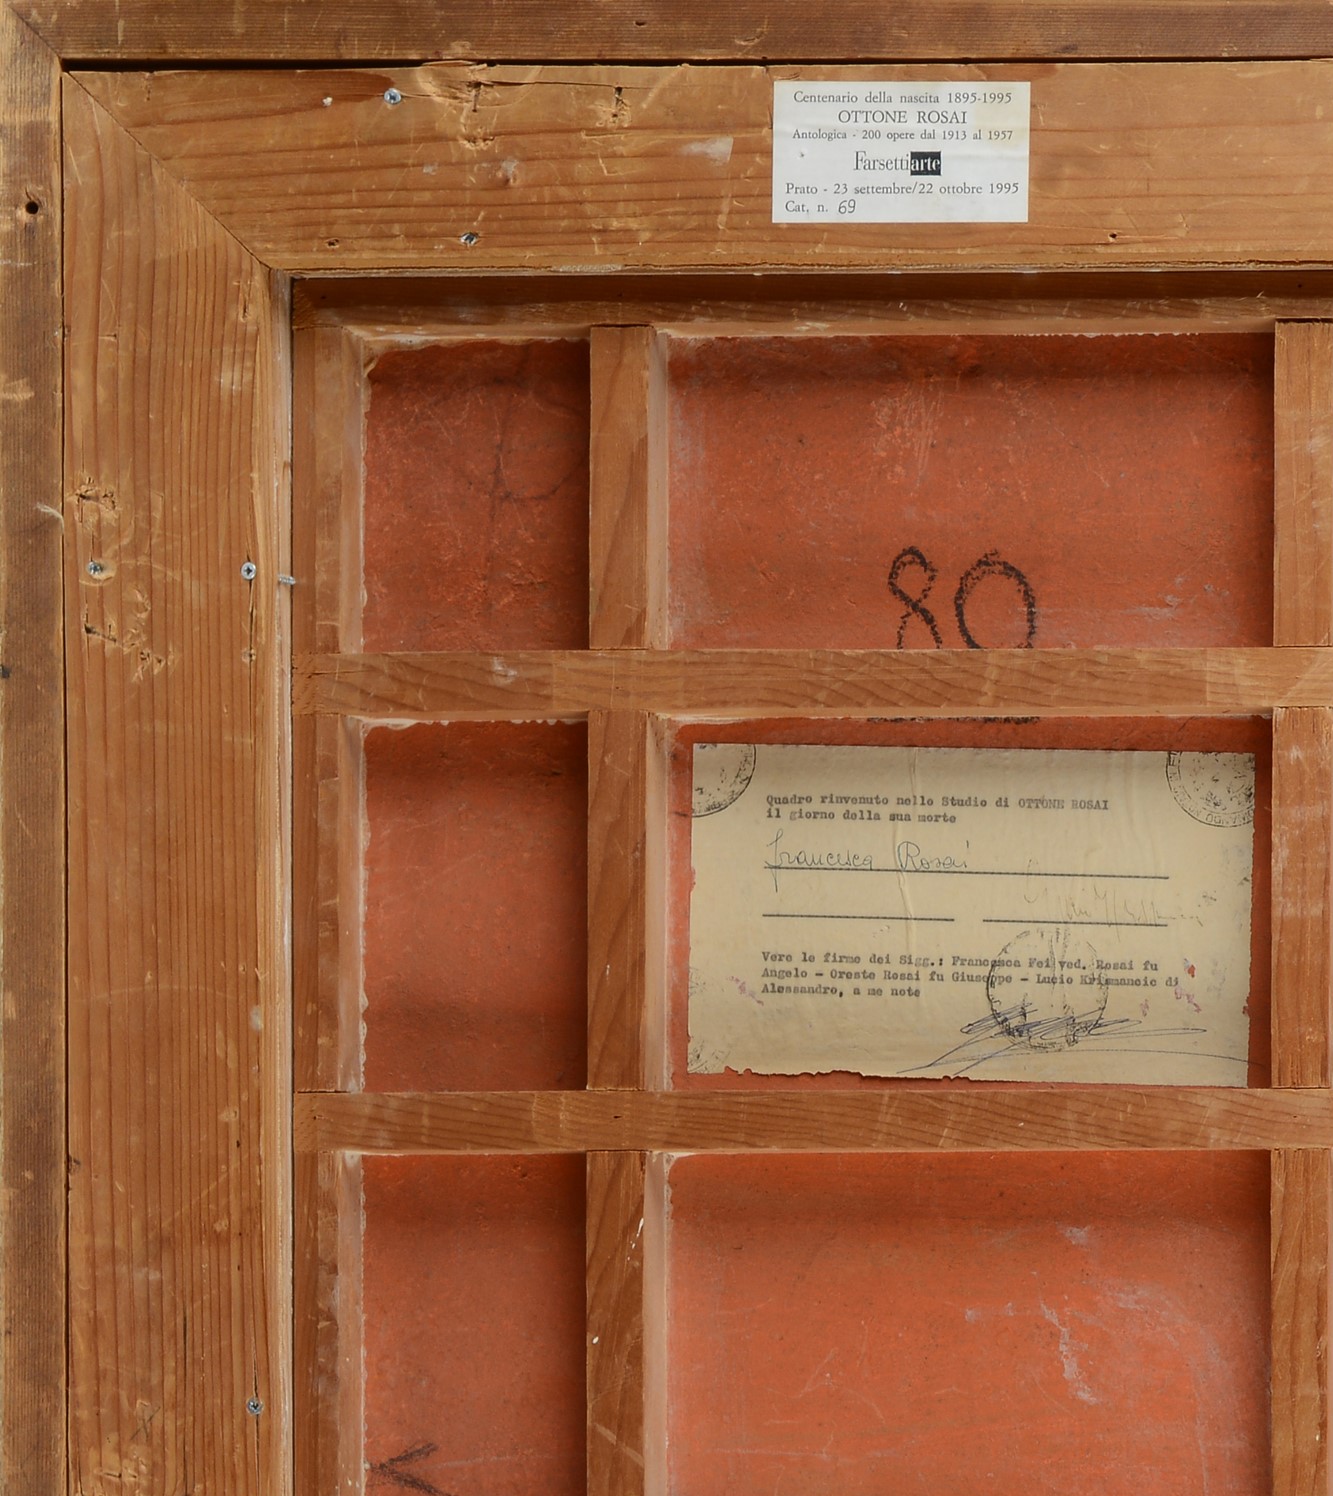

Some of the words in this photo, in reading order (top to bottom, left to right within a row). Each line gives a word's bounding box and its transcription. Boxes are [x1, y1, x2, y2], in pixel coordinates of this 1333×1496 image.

[793, 91, 858, 104] Centenario
[864, 91, 893, 104] della
[899, 92, 940, 104] nascita
[947, 92, 1012, 104] 1895-1995
[837, 110, 907, 124] OTTONE
[916, 110, 968, 124] ROSAI
[792, 129, 847, 142] Antologica
[862, 130, 881, 140] 200
[886, 131, 915, 142] opere
[920, 129, 936, 140] dal
[941, 130, 967, 140] 1913
[972, 129, 982, 140] al
[987, 130, 1013, 141] 1957
[785, 183, 818, 195] Prato
[833, 183, 848, 195] 23
[853, 181, 934, 195] settembre/22
[938, 182, 983, 195] ottobre
[989, 182, 1019, 195] 1995
[817, 203, 829, 213] n.
[766, 795, 813, 807] Quadro
[820, 794, 889, 805] rinvenuto
[896, 796, 934, 807] nello
[941, 796, 987, 807] Studio
[995, 797, 1010, 808] di
[1018, 798, 1065, 809] OTTONE
[1071, 799, 1109, 810] ROSAI
[766, 809, 781, 819] il
[789, 808, 835, 821] giorno
[843, 809, 881, 821] della
[889, 813, 912, 822] sua
[917, 812, 956, 823] morte
[761, 951, 793, 963] Vere
[801, 951, 816, 963] le
[823, 952, 861, 964] firme
[869, 953, 891, 965] dei
[1096, 959, 1134, 971] Rosai
[1143, 959, 1159, 971] fu
[761, 968, 808, 980] Angelo
[830, 969, 876, 980] Oreste
[883, 970, 921, 981] Rosai
[928, 971, 945, 982] fu
[1036, 974, 1074, 985] Lucio
[1165, 976, 1179, 987] di
[761, 984, 844, 998] Alessandro,
[852, 986, 861, 996] a
[867, 987, 883, 997] me
[890, 986, 921, 998] note
